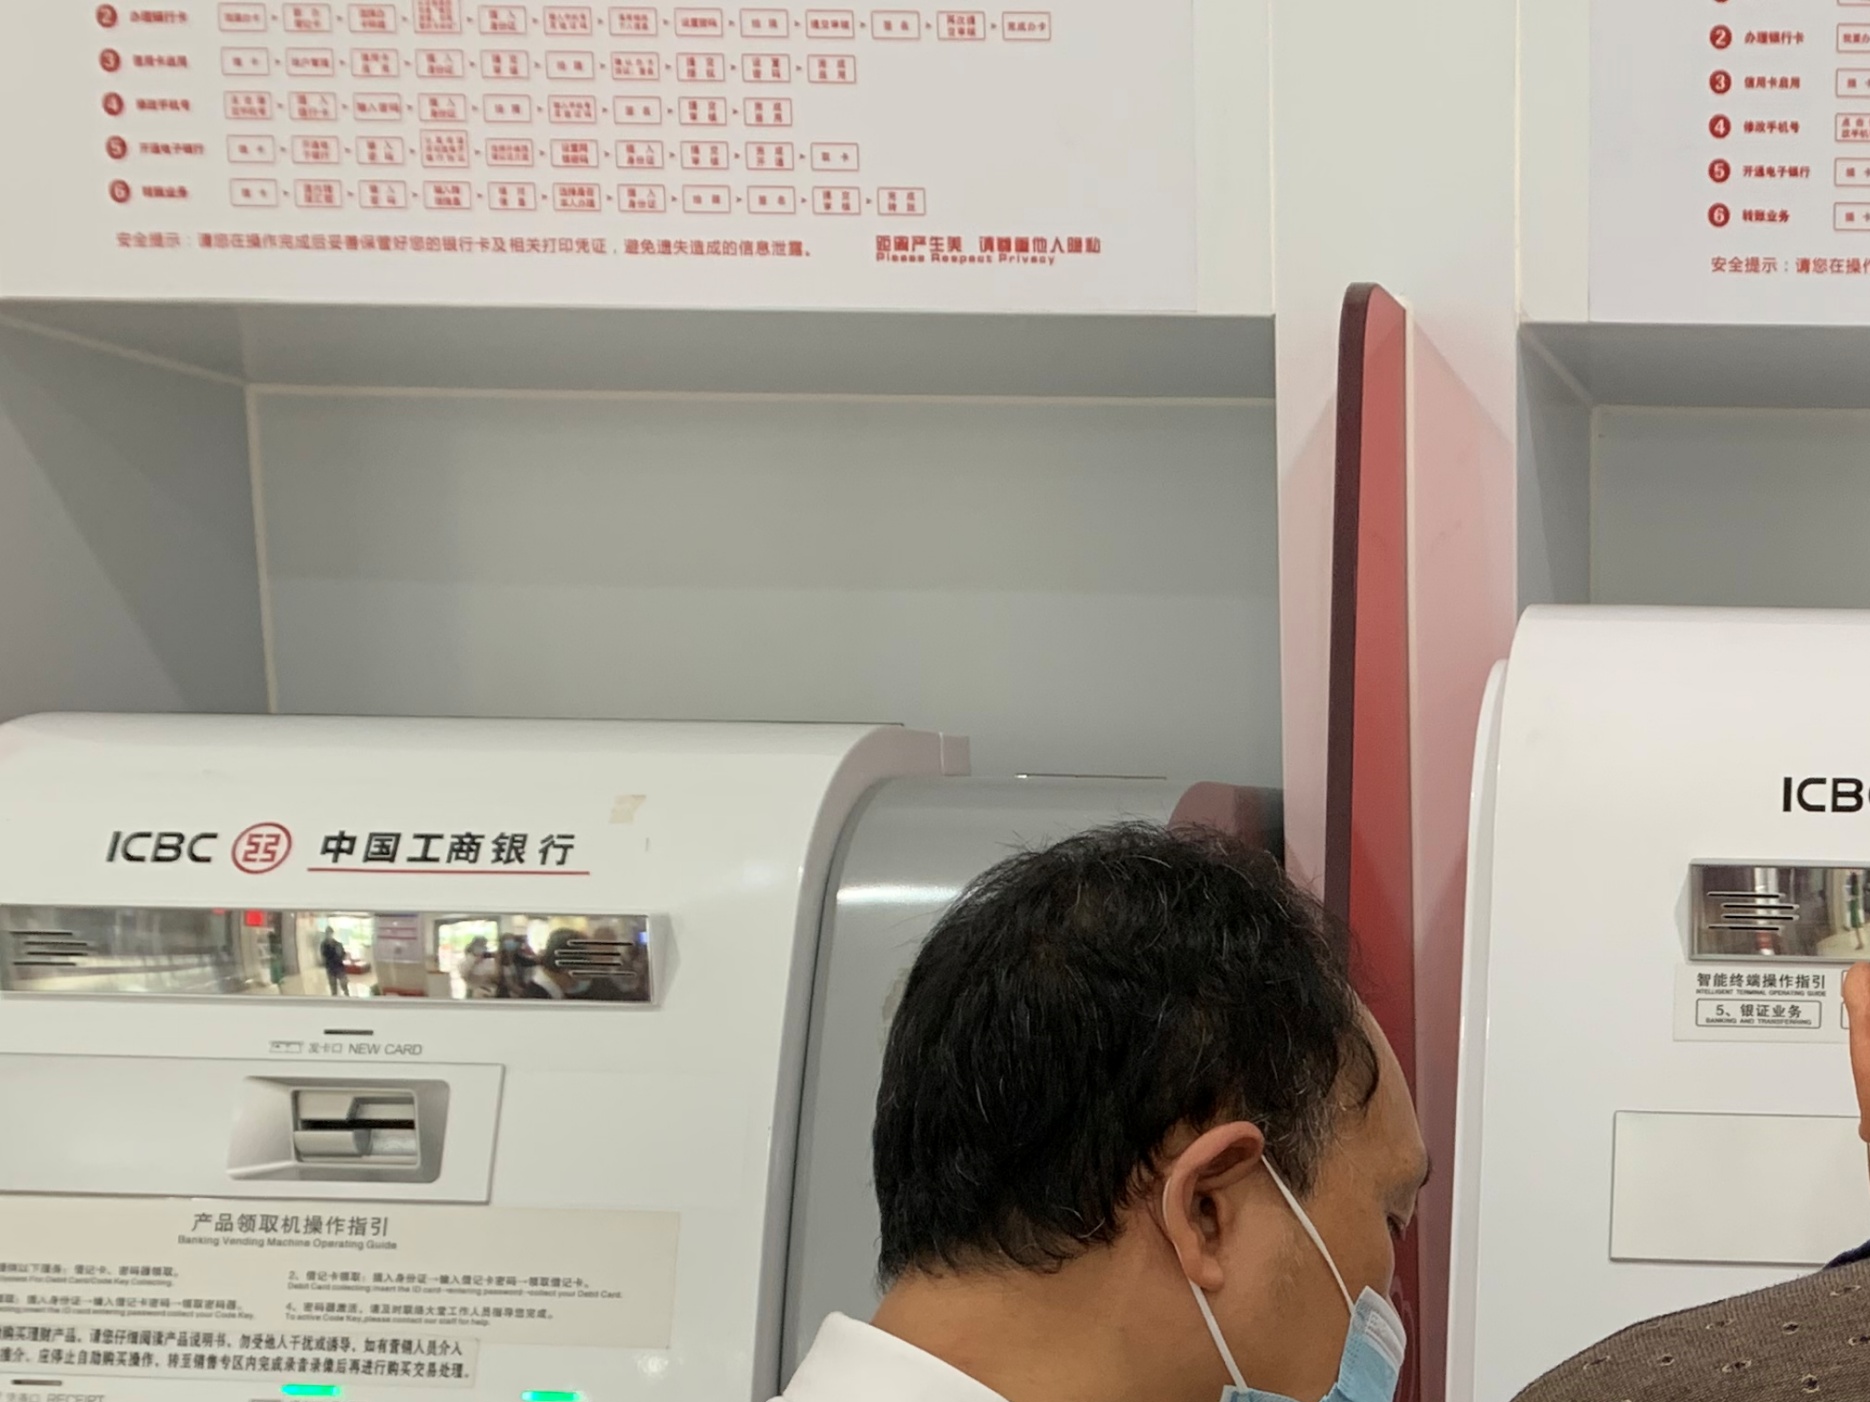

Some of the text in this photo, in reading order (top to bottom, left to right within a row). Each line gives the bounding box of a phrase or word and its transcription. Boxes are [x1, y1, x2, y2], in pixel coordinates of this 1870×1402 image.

[1744, 32, 1804, 45] 办理银行卡
[1744, 76, 1800, 89] 信用卡启用
[1744, 121, 1800, 133] 修改手机号
[1742, 165, 1810, 178] 开通电子银行
[1742, 209, 1790, 222] 转账业务
[876, 252, 1055, 266] Please Respect Privacy
[106, 830, 219, 864] ICBC
[320, 830, 577, 868] 中国工商银行
[1697, 972, 1826, 990] 智能终端操作指引
[348, 1042, 381, 1055] NEW
[384, 1043, 423, 1056] CARD
[191, 1212, 389, 1237] 产品领取机操作指引
[178, 1234, 397, 1250] Banking Vending Machine Operating Guide
